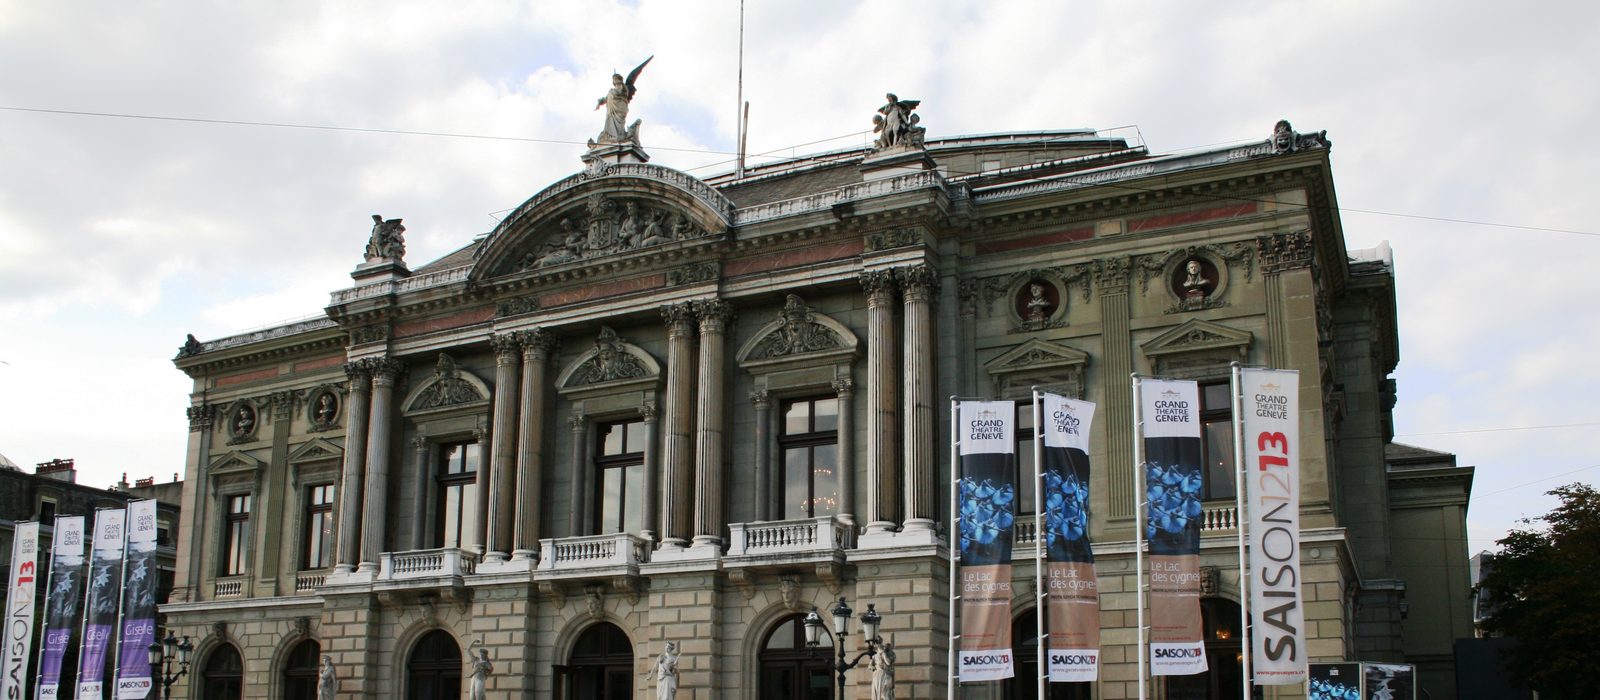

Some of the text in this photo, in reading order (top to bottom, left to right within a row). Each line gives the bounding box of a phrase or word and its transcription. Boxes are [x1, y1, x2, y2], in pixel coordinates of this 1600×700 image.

[1155, 400, 1189, 408] GRAND
[1255, 394, 1288, 404] GRAND
[971, 419, 1004, 427] GRAND
[1151, 561, 1180, 571] Le Lac
[963, 572, 992, 582] Le Lac
[1050, 568, 1078, 578] Le Lac
[1151, 572, 1201, 584] des cygnes
[964, 581, 1010, 594] des cygnes
[1050, 578, 1067, 588] des
